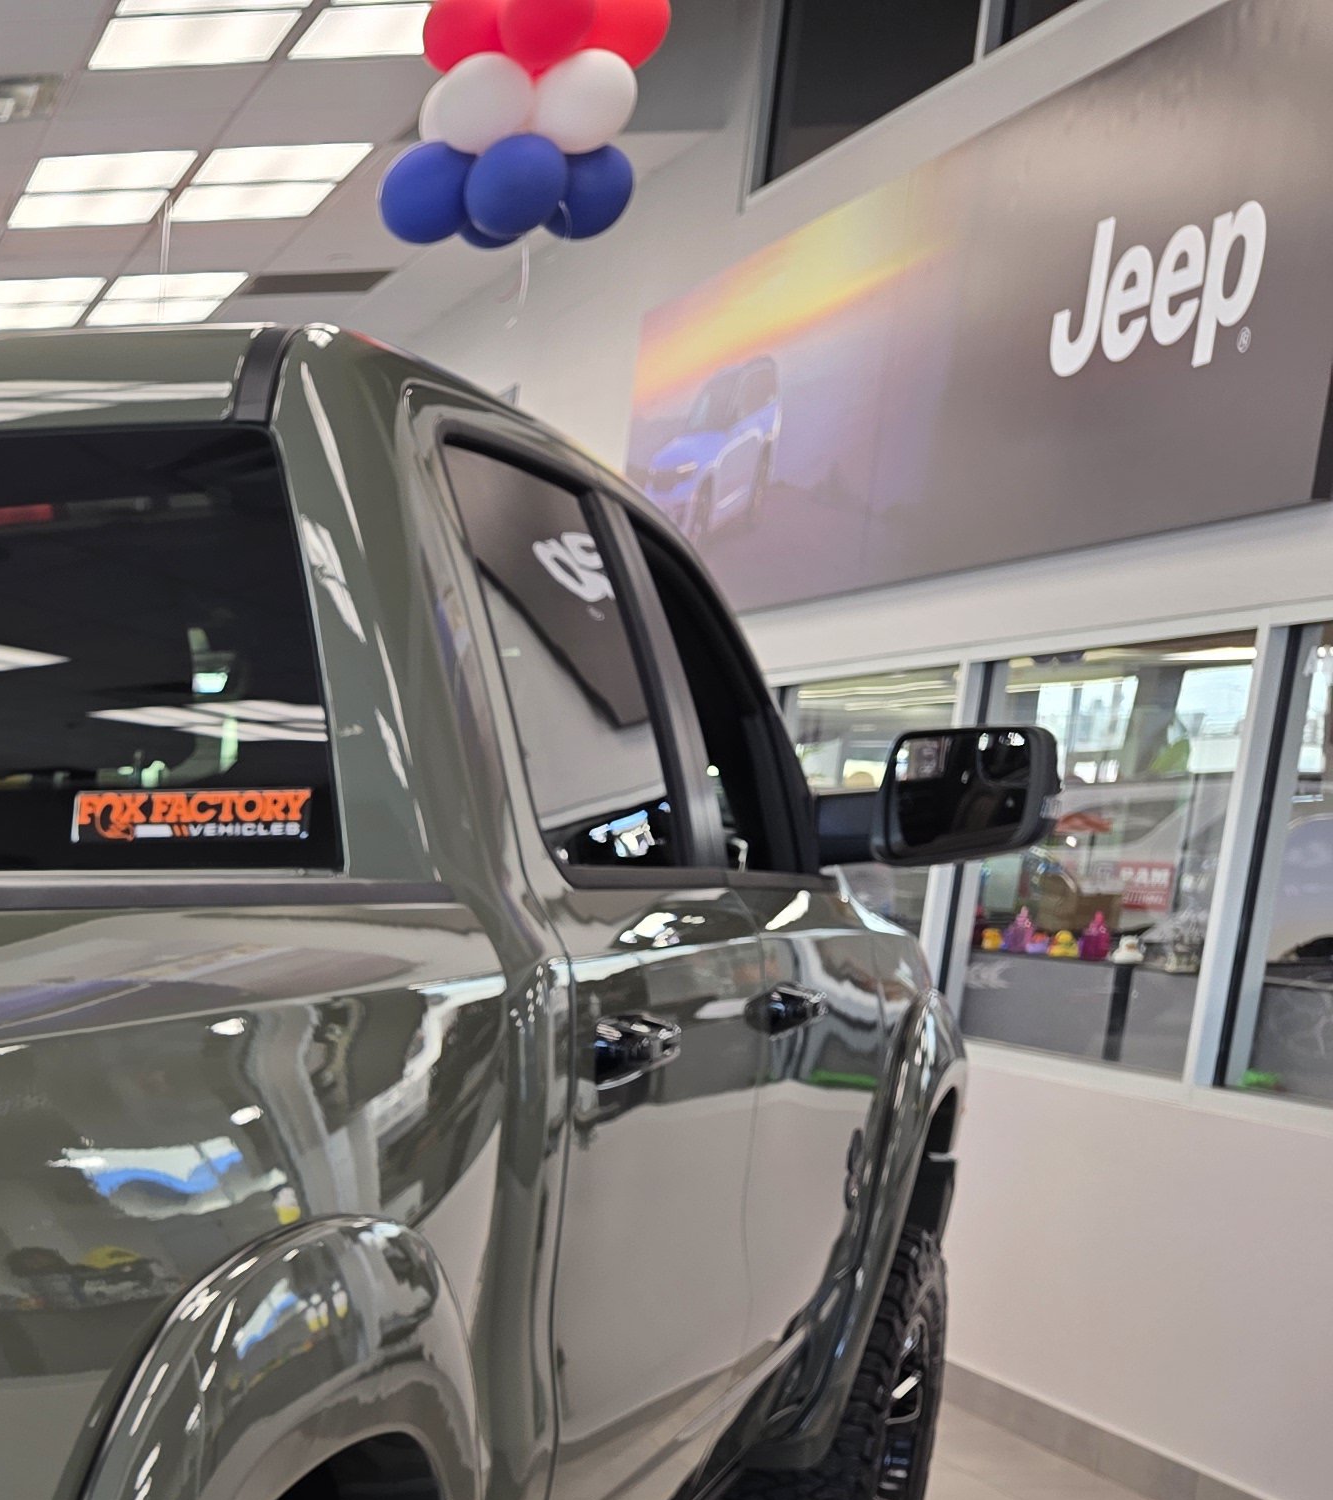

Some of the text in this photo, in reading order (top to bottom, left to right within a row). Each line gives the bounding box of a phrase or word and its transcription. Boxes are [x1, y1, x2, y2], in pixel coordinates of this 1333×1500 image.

[1050, 200, 1266, 377] Jeep
[78, 789, 312, 842] FOX FACTORY
[189, 822, 301, 837] VEHICLES
